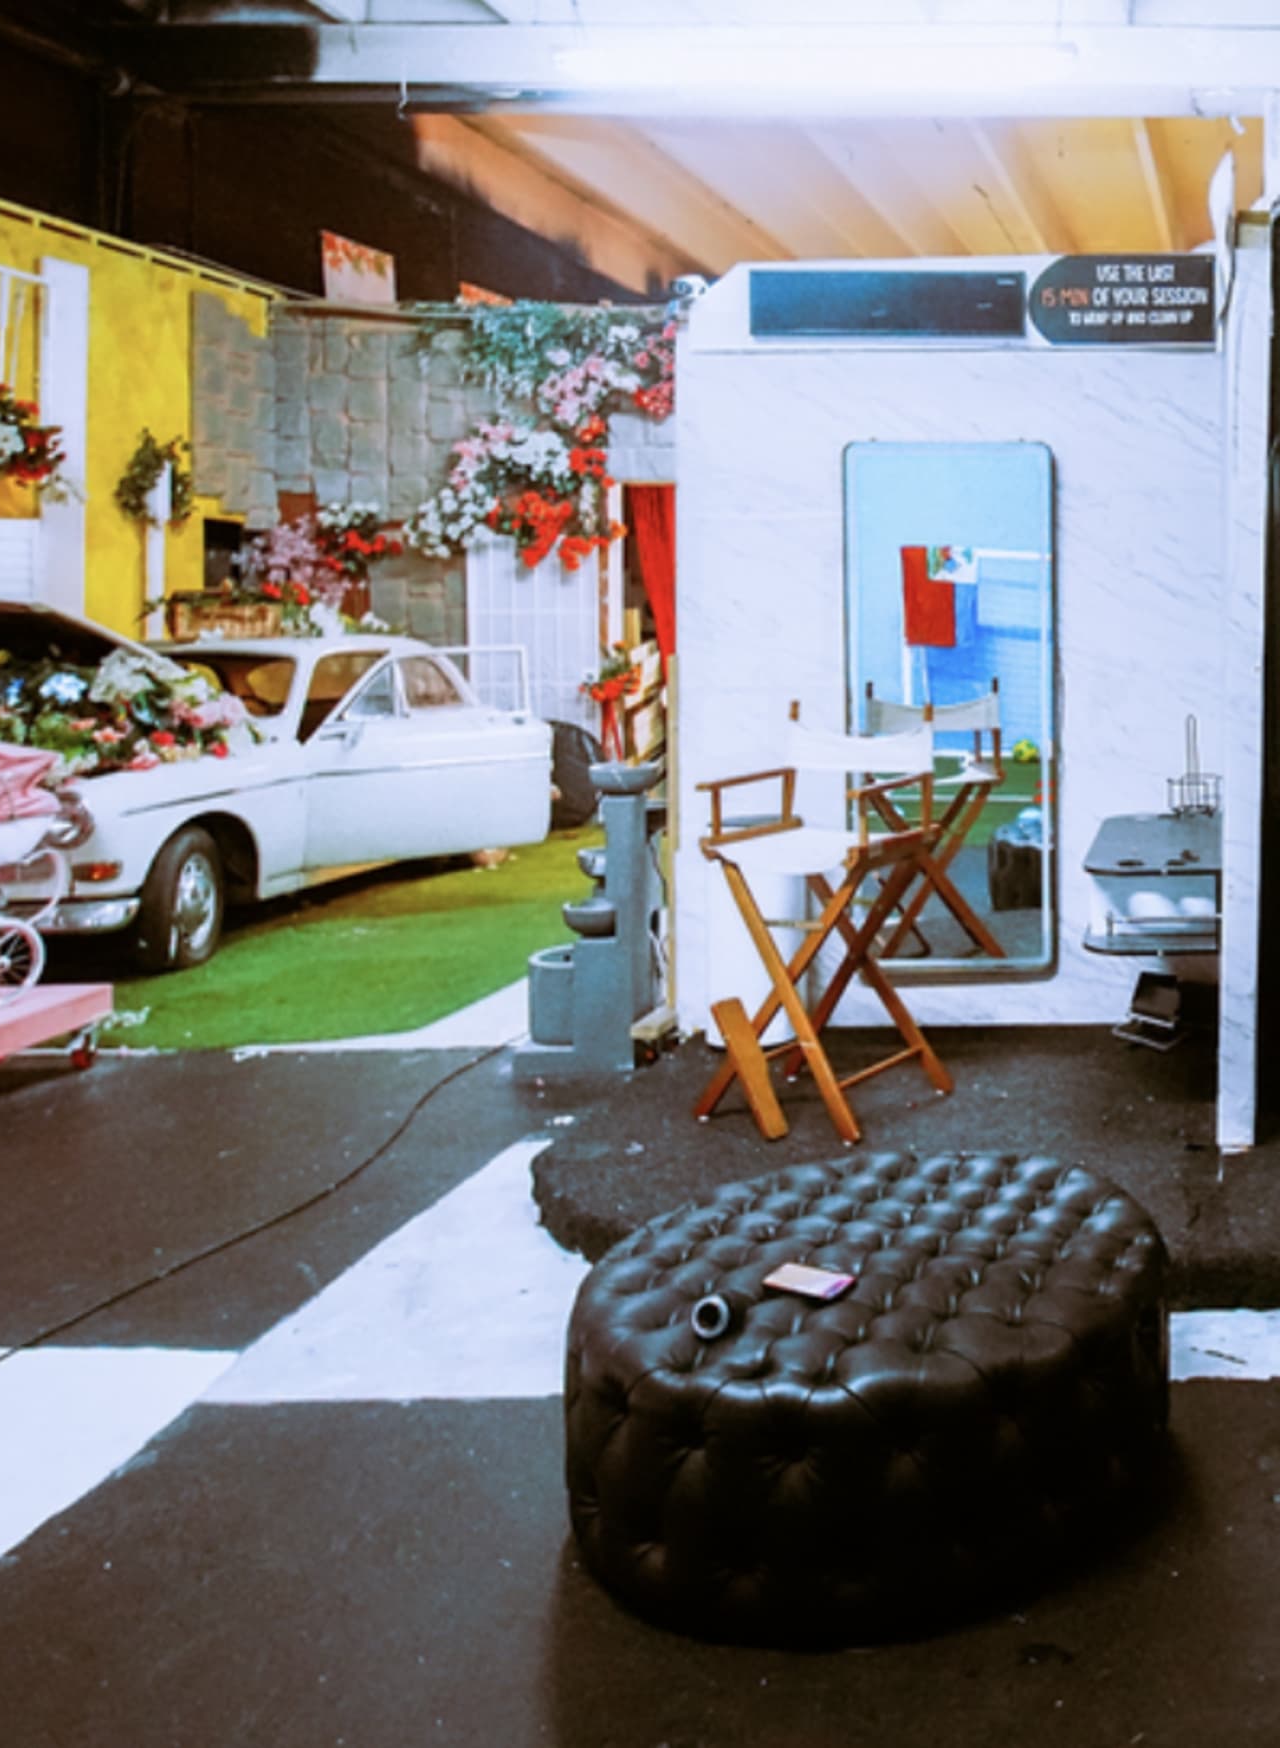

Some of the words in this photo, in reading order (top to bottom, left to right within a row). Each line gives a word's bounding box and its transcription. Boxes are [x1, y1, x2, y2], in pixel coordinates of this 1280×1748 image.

[1096, 264, 1120, 282] USE
[1123, 264, 1145, 282] THE
[1147, 264, 1175, 282] LAST
[1041, 288, 1056, 307] 15
[1060, 288, 1089, 307] MIN
[1092, 288, 1109, 307] OF
[1112, 288, 1149, 306] YOUR
[1151, 287, 1208, 305] SESSION
[1068, 311, 1081, 325] TO
[1084, 311, 1109, 324] WRAP
[1112, 311, 1124, 324] UP
[1127, 311, 1146, 324] AND
[1148, 311, 1178, 324] CLEAN
[1180, 310, 1194, 324] UP
